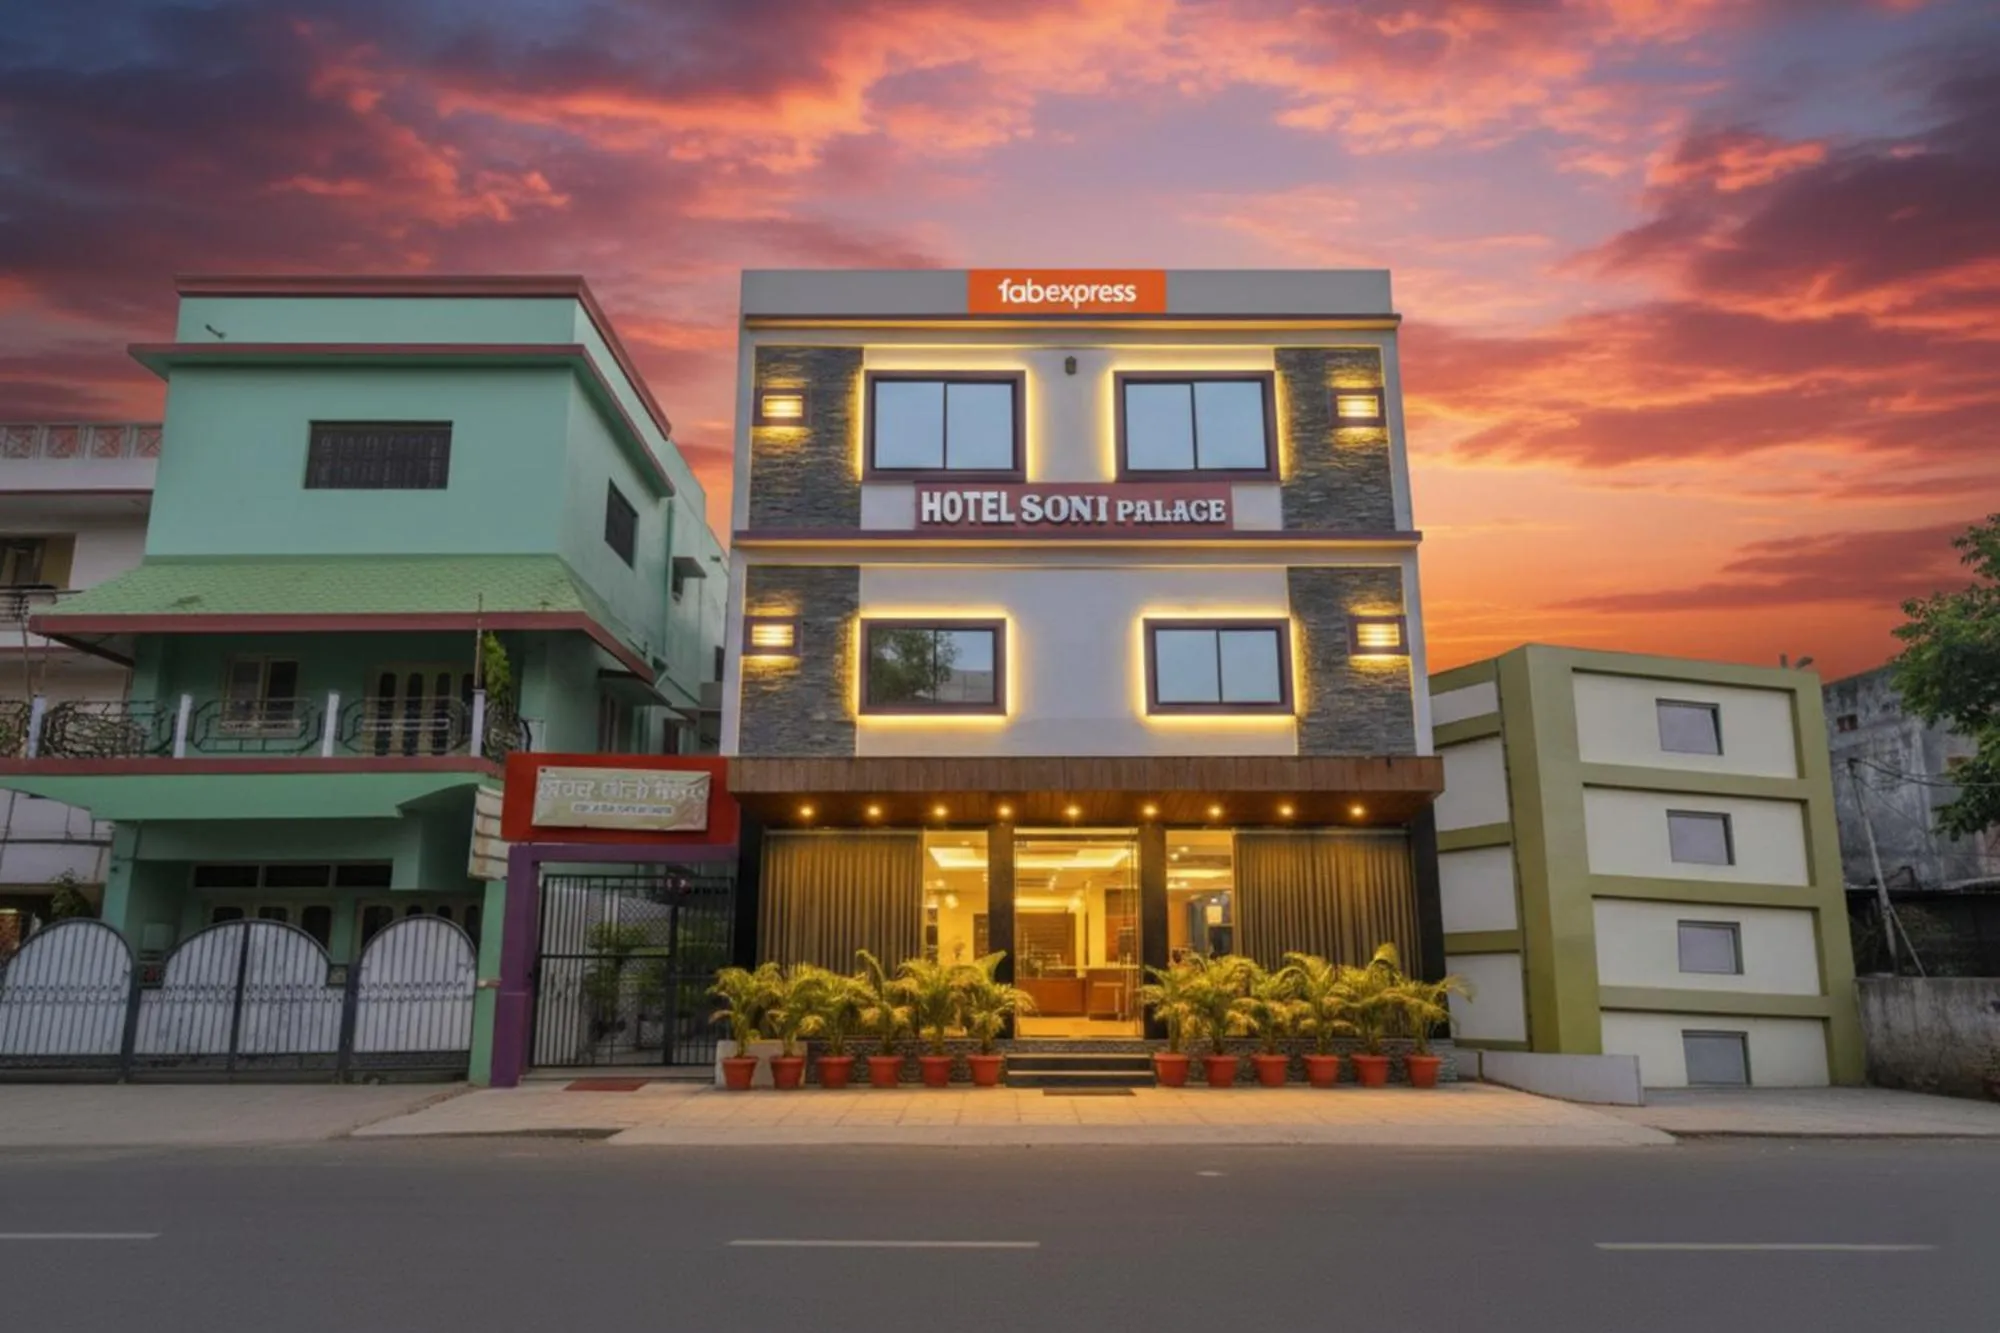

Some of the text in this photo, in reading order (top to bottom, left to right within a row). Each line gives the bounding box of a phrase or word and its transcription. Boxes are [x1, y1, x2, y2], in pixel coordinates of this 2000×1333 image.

[998, 278, 1137, 310] fabexpress
[921, 491, 1226, 523] HOTEL SONI PALACE
